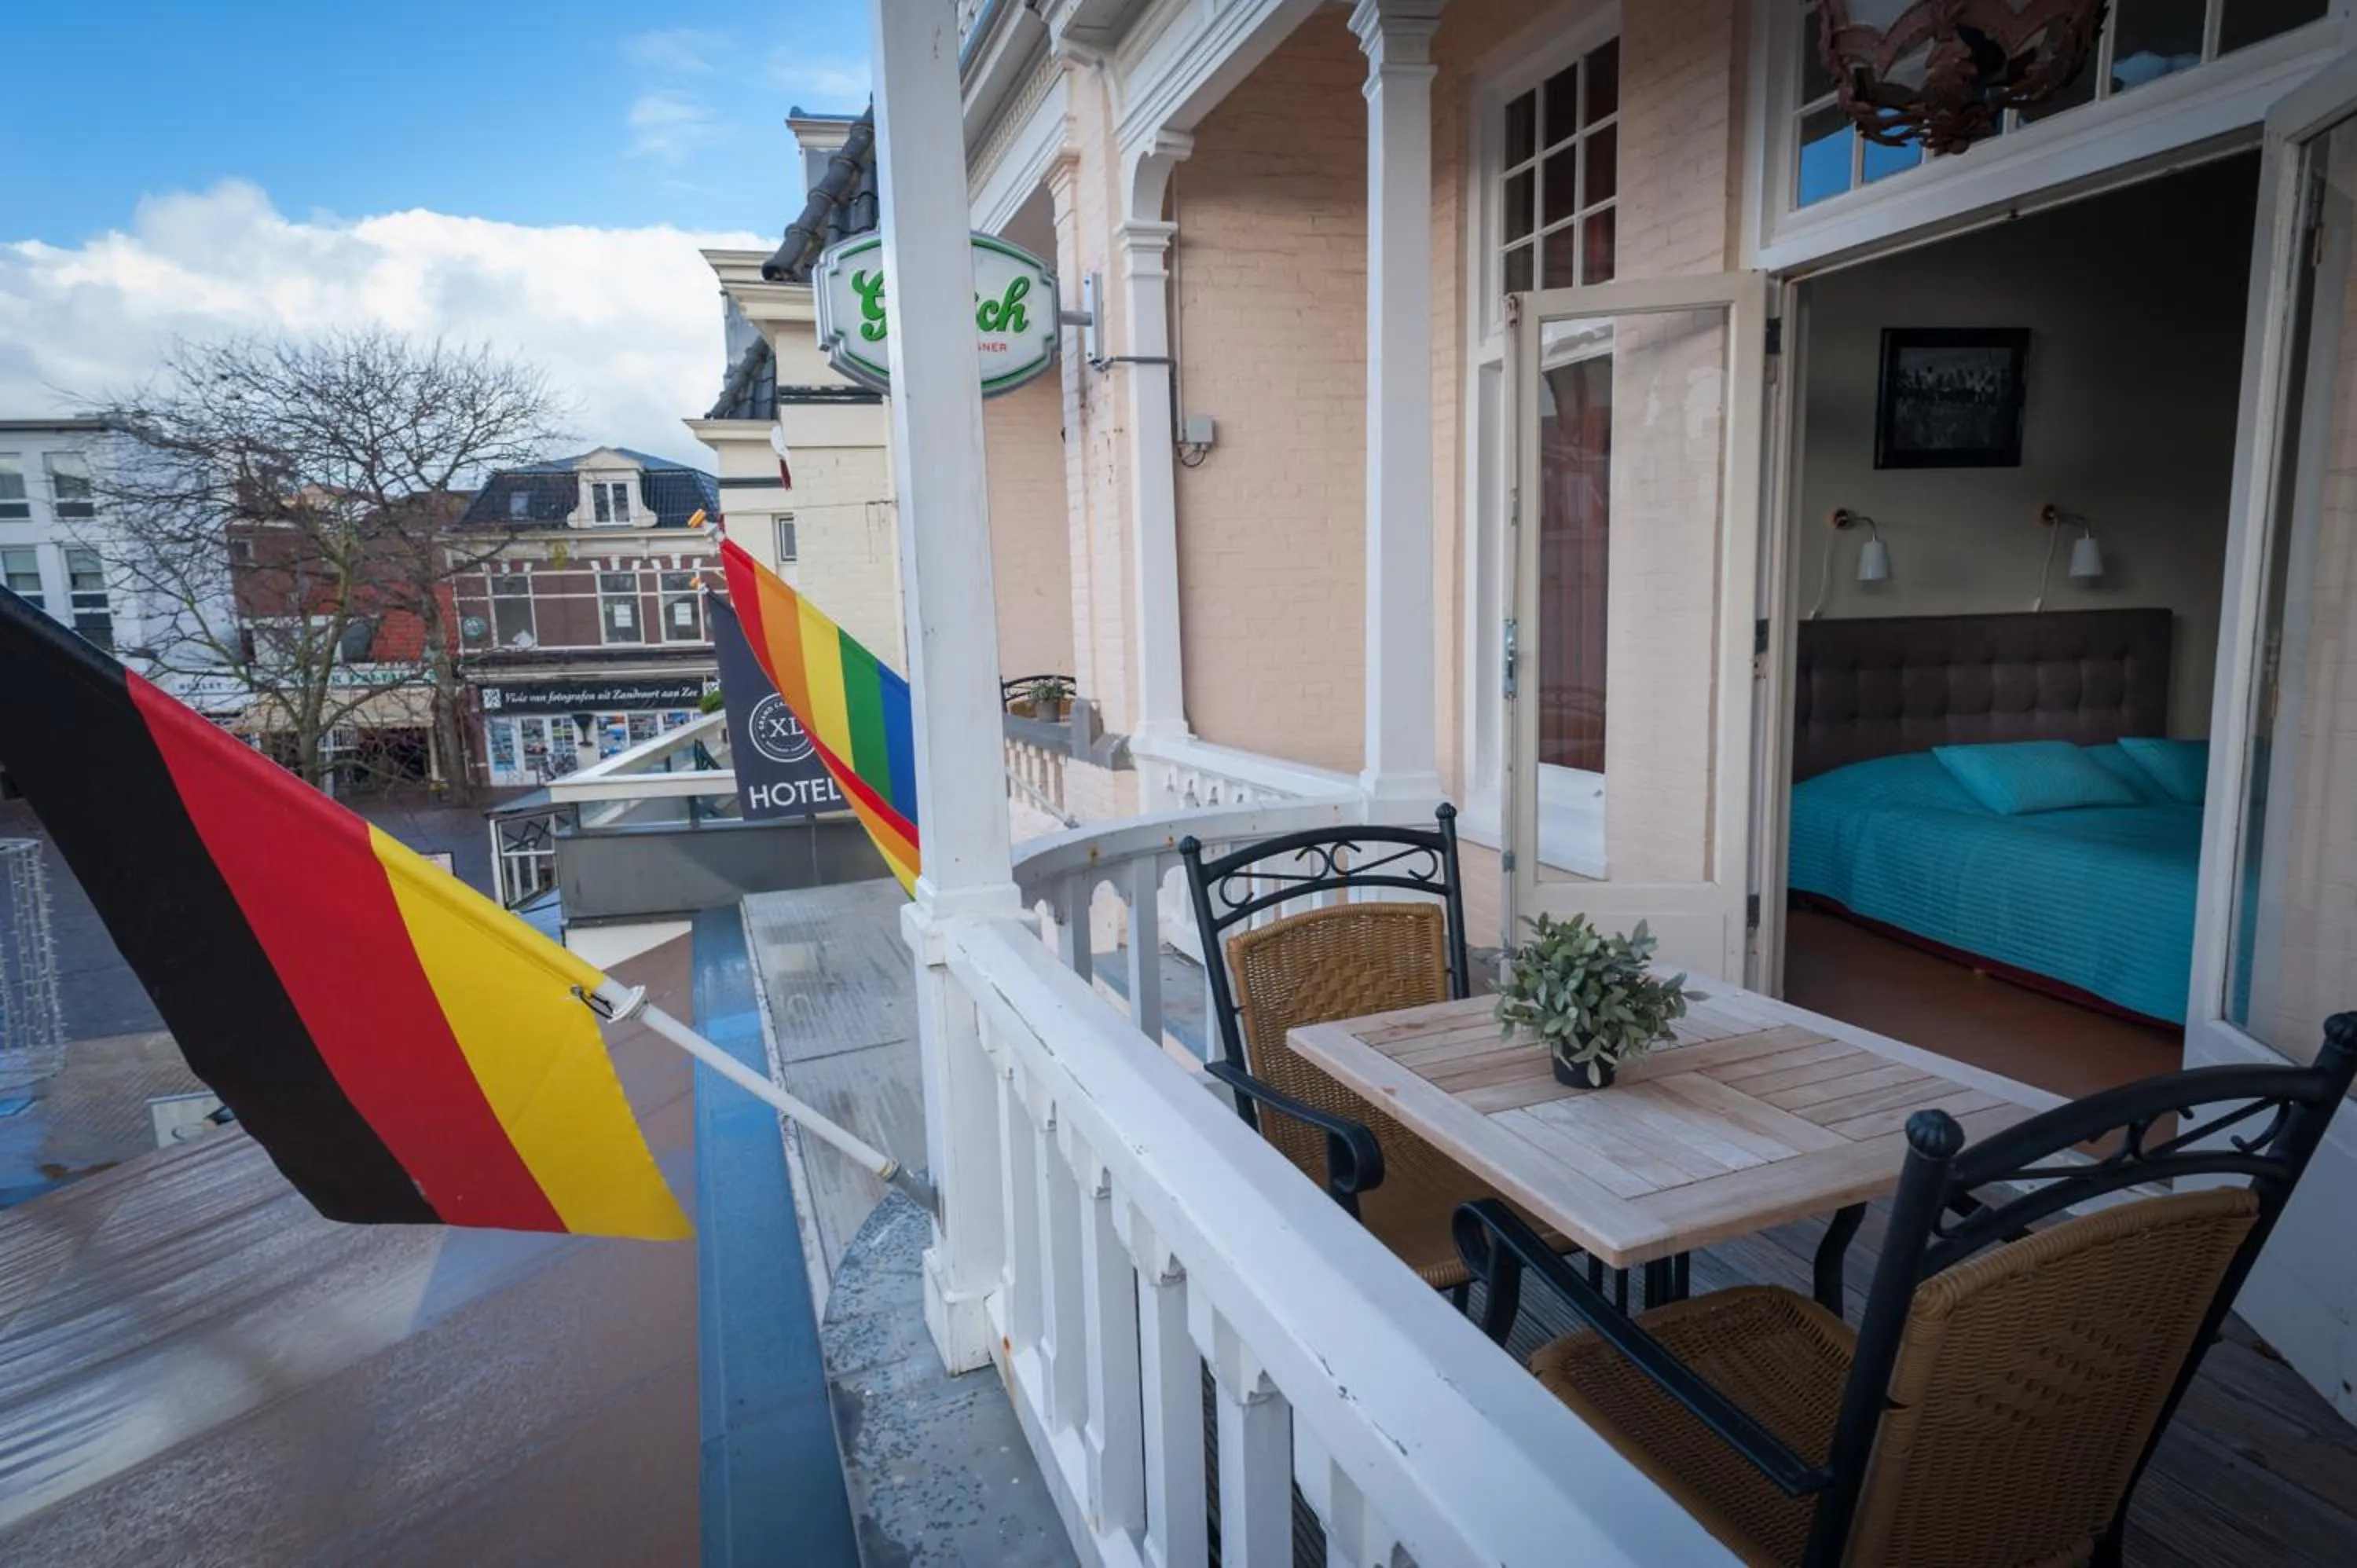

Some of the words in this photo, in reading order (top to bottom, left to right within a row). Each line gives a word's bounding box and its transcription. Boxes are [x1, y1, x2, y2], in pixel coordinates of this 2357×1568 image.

[612, 687, 661, 701] Zandvoort
[768, 716, 805, 738] XL
[749, 777, 842, 810] HOTEL
